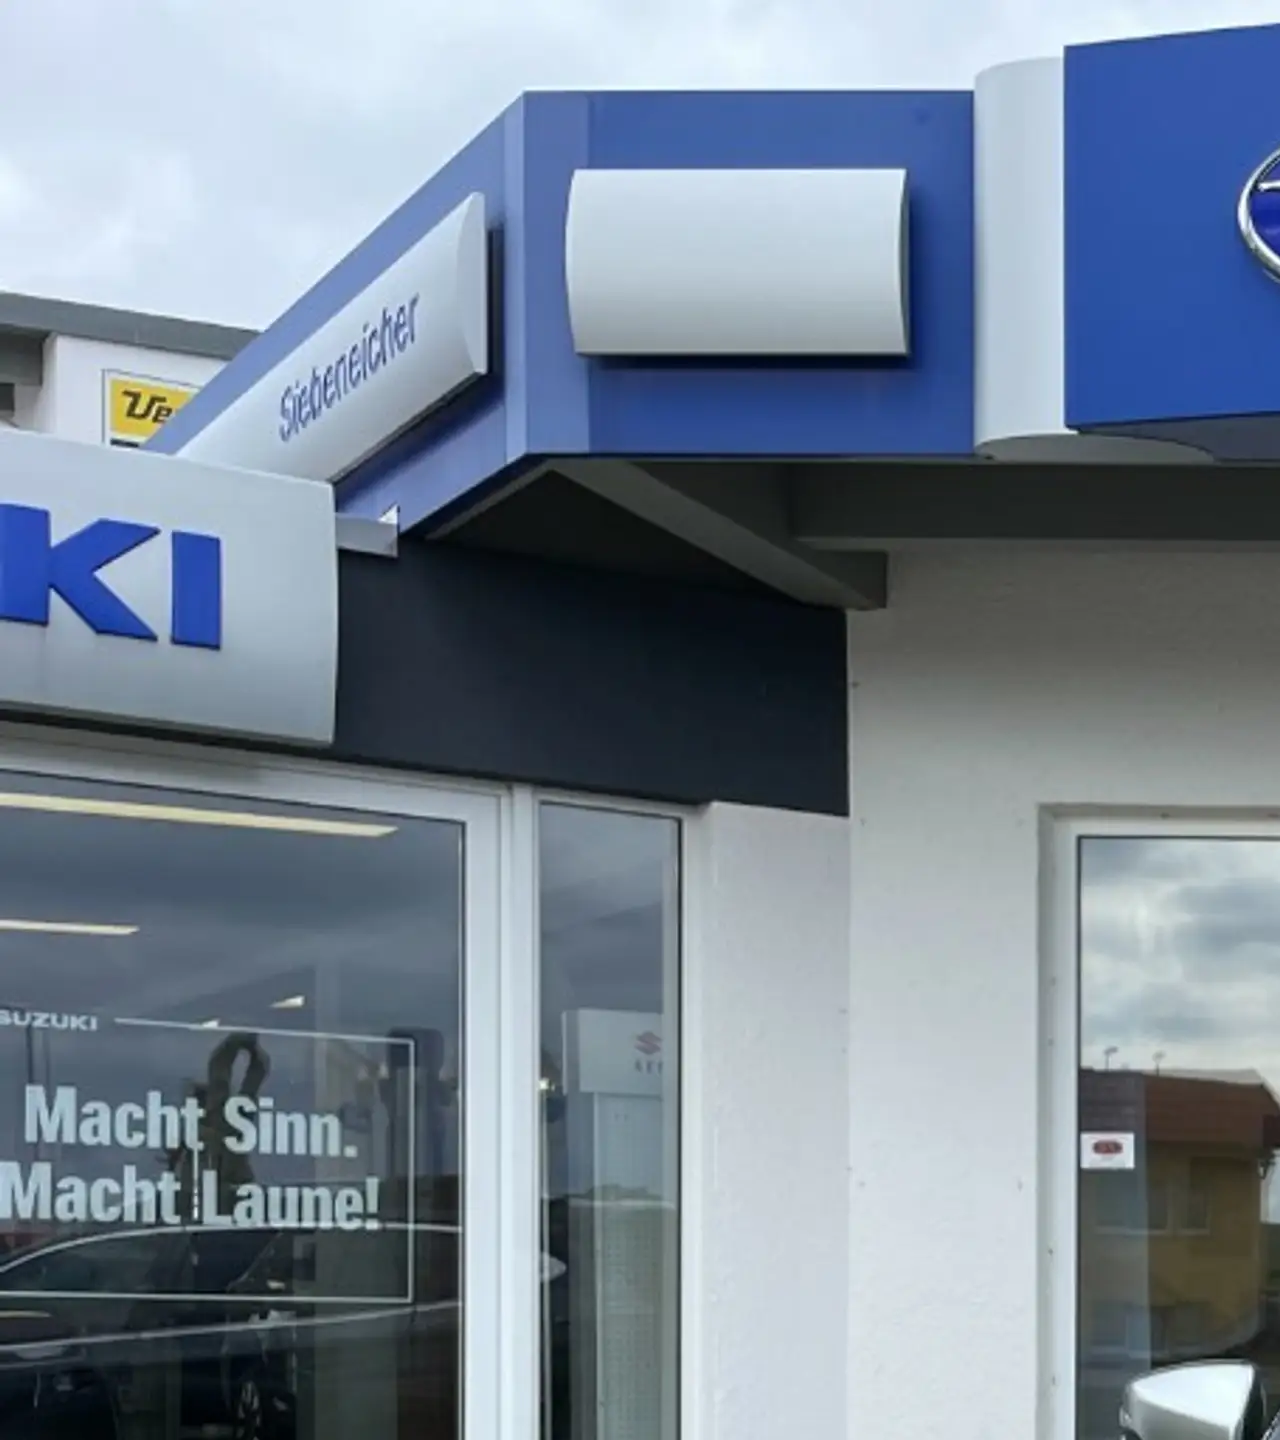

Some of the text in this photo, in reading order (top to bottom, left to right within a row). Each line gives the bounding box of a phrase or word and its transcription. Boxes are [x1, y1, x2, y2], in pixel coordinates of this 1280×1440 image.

[279, 292, 420, 442] Siebeneicher
[0, 503, 221, 651] KI
[0, 1009, 98, 1031] SUZUKI
[24, 1084, 358, 1158] Macht Sinn.
[0, 1160, 379, 1230] Macht Laune!
